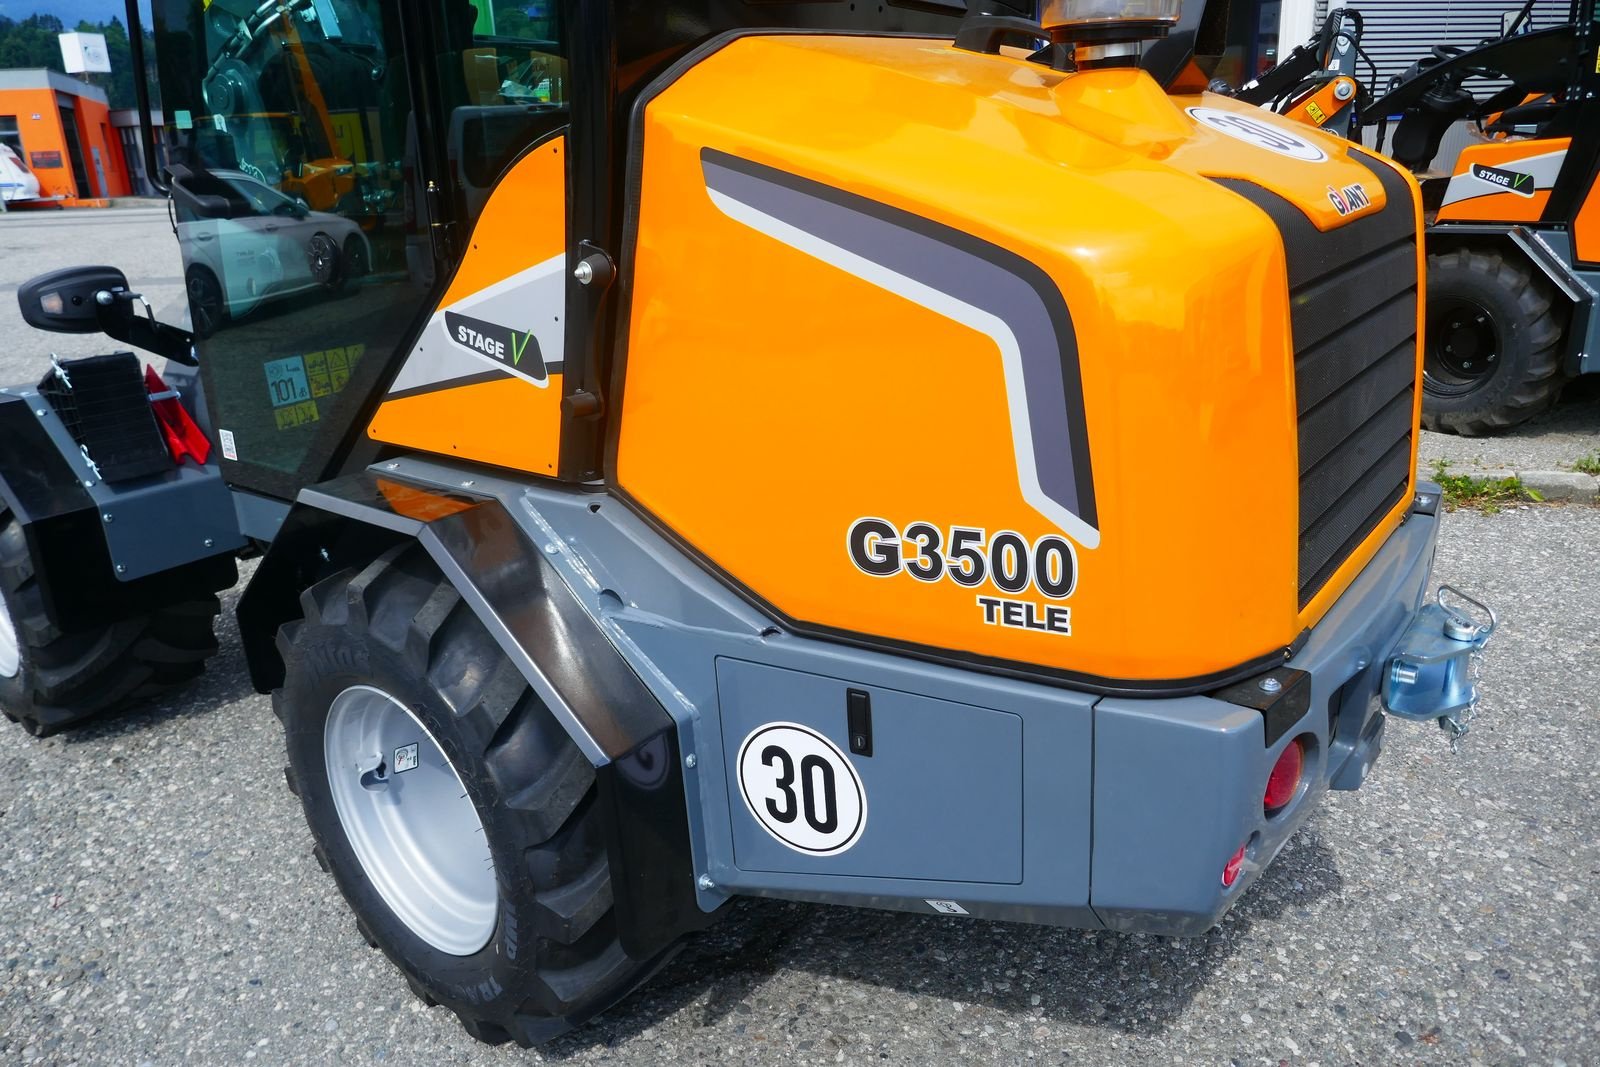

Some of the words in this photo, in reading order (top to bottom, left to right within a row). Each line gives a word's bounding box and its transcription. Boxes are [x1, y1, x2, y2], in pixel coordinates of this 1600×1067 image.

[1207, 116, 1305, 151] 30
[1478, 169, 1510, 186] STAGE
[1513, 172, 1534, 189] V
[1327, 184, 1371, 216] GIANT
[458, 325, 505, 360] STAGE
[511, 329, 532, 366] V
[270, 377, 298, 403] 101
[847, 516, 1078, 600] G3500
[976, 595, 1072, 636] TELE
[761, 744, 838, 834] 30
